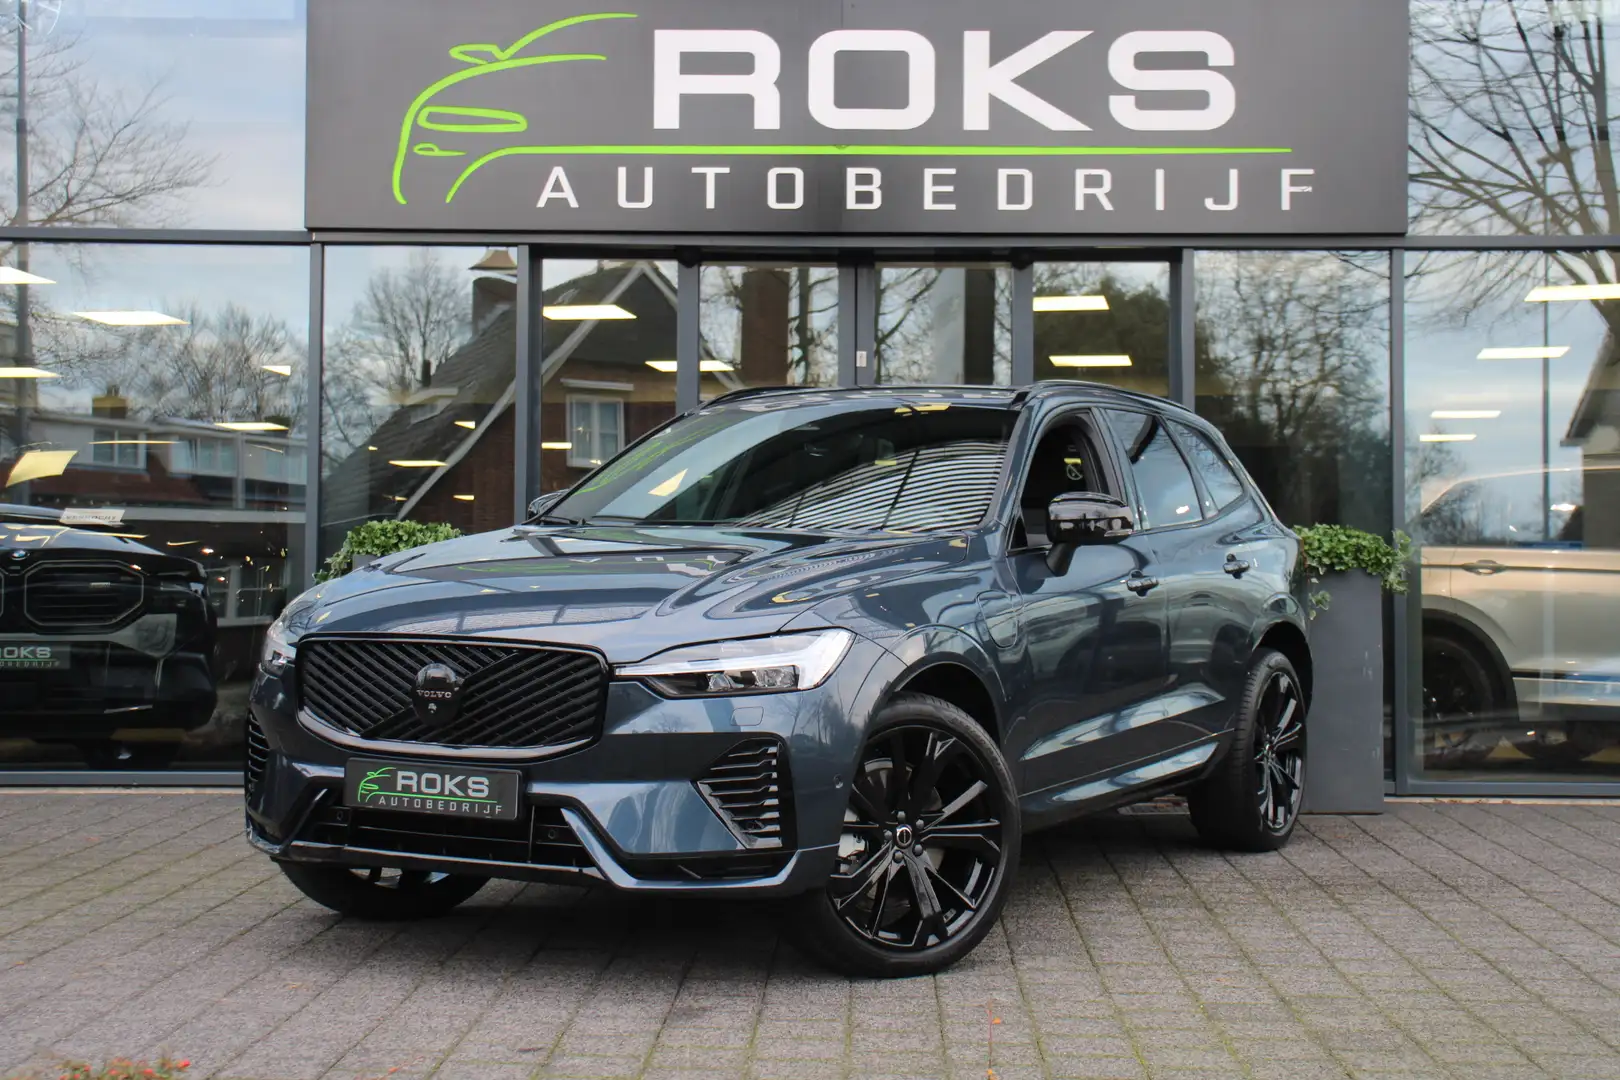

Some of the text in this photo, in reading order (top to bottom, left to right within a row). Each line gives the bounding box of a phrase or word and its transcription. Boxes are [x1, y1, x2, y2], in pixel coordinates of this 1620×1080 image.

[653, 28, 1237, 132] ROKS
[535, 165, 1316, 211] AUTOBEDRIJF
[0, 646, 52, 659] OKS
[416, 689, 452, 699] VOLVO
[396, 770, 490, 798] ROKS
[378, 795, 502, 815] AUTOBEDRIJF
